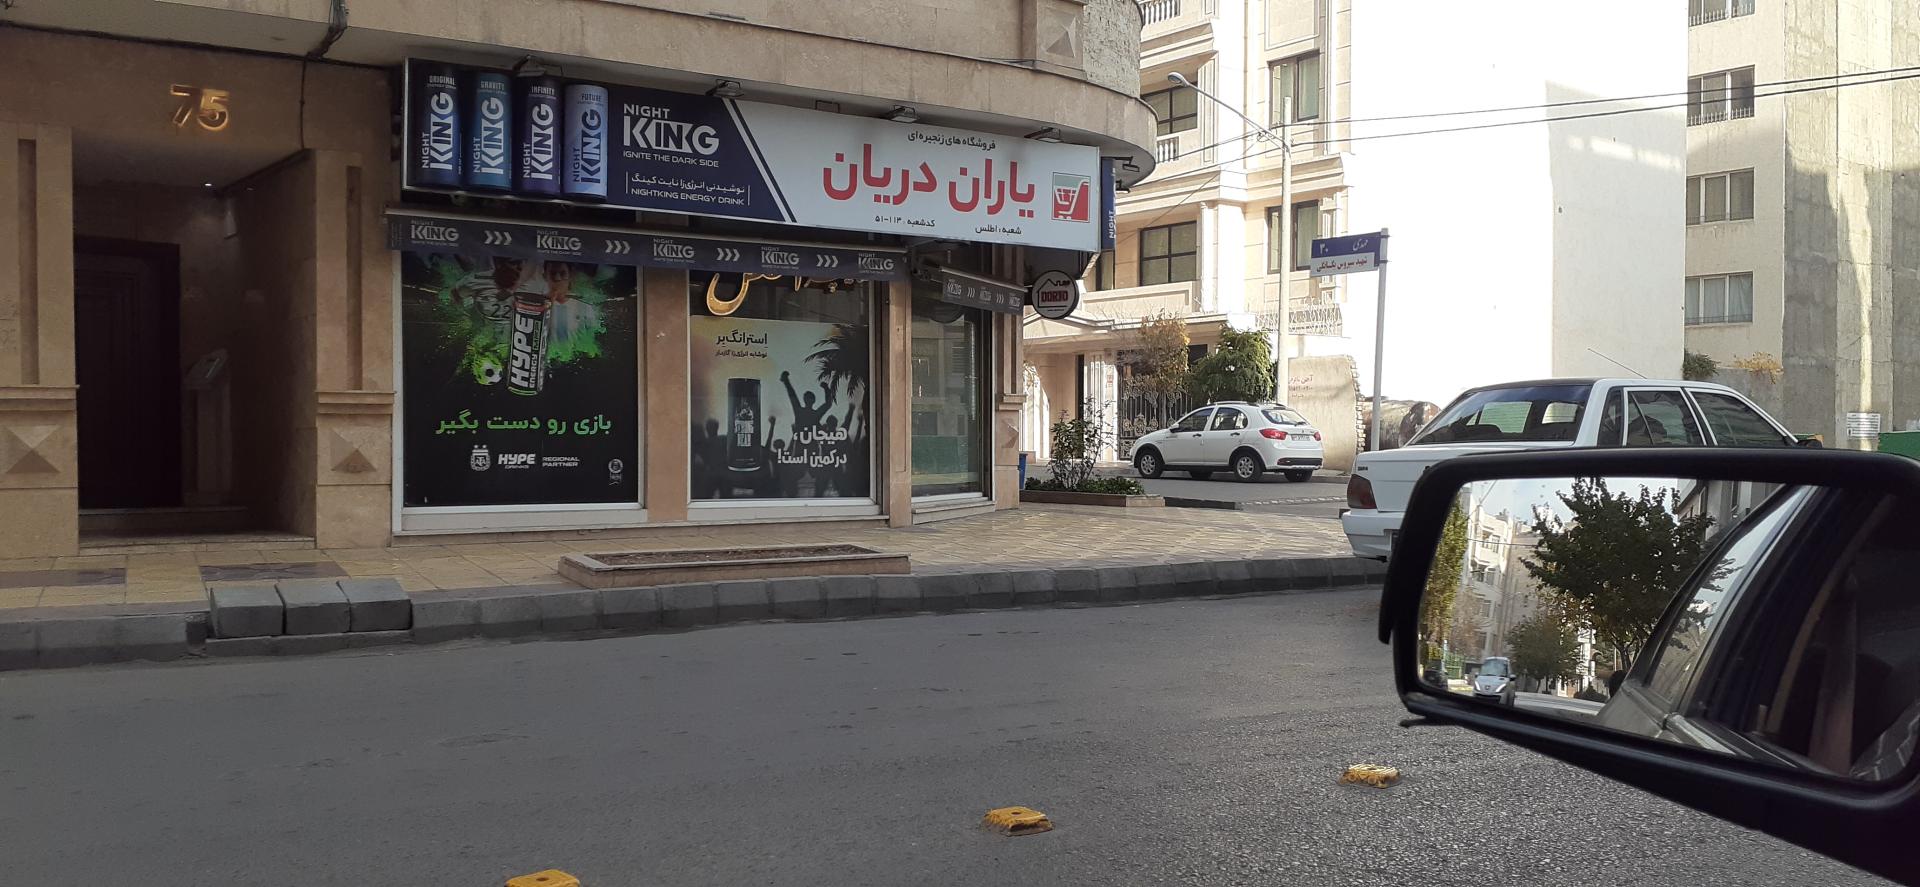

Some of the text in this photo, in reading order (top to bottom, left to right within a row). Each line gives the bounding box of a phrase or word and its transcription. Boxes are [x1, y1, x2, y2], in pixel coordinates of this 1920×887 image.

[170, 84, 230, 131] 75
[623, 103, 670, 119] NIGHT
[430, 92, 454, 170] KING
[481, 97, 504, 175] KING
[623, 115, 720, 155] KING
[422, 132, 430, 169] NIGHT
[531, 103, 554, 180] KING
[581, 109, 602, 184] KING
[962, 136, 996, 151] فروشگاه
[473, 137, 481, 173] NIGHT
[523, 143, 531, 178] NIGHT
[623, 150, 720, 168] IGNITE THE DARK SIDE
[573, 147, 581, 182] NIGHT
[631, 173, 658, 185] کینگ
[658, 176, 679, 187] نایت
[822, 143, 1035, 218] یاران دریان
[631, 188, 679, 199] NIGHTKING
[680, 193, 717, 204] ENERGY
[705, 183, 745, 195] نوشیدنی
[411, 224, 460, 242] KING
[974, 223, 998, 234] اطلس
[537, 236, 582, 251] KING
[653, 243, 695, 259] KING
[761, 251, 800, 265] KING
[858, 257, 894, 270] KING
[490, 303, 512, 318] 22
[511, 313, 534, 388] HYPE
[529, 353, 539, 389] ENERGY
[435, 409, 612, 435] بازی رو دست بگیر
[498, 453, 536, 465] HYPE
